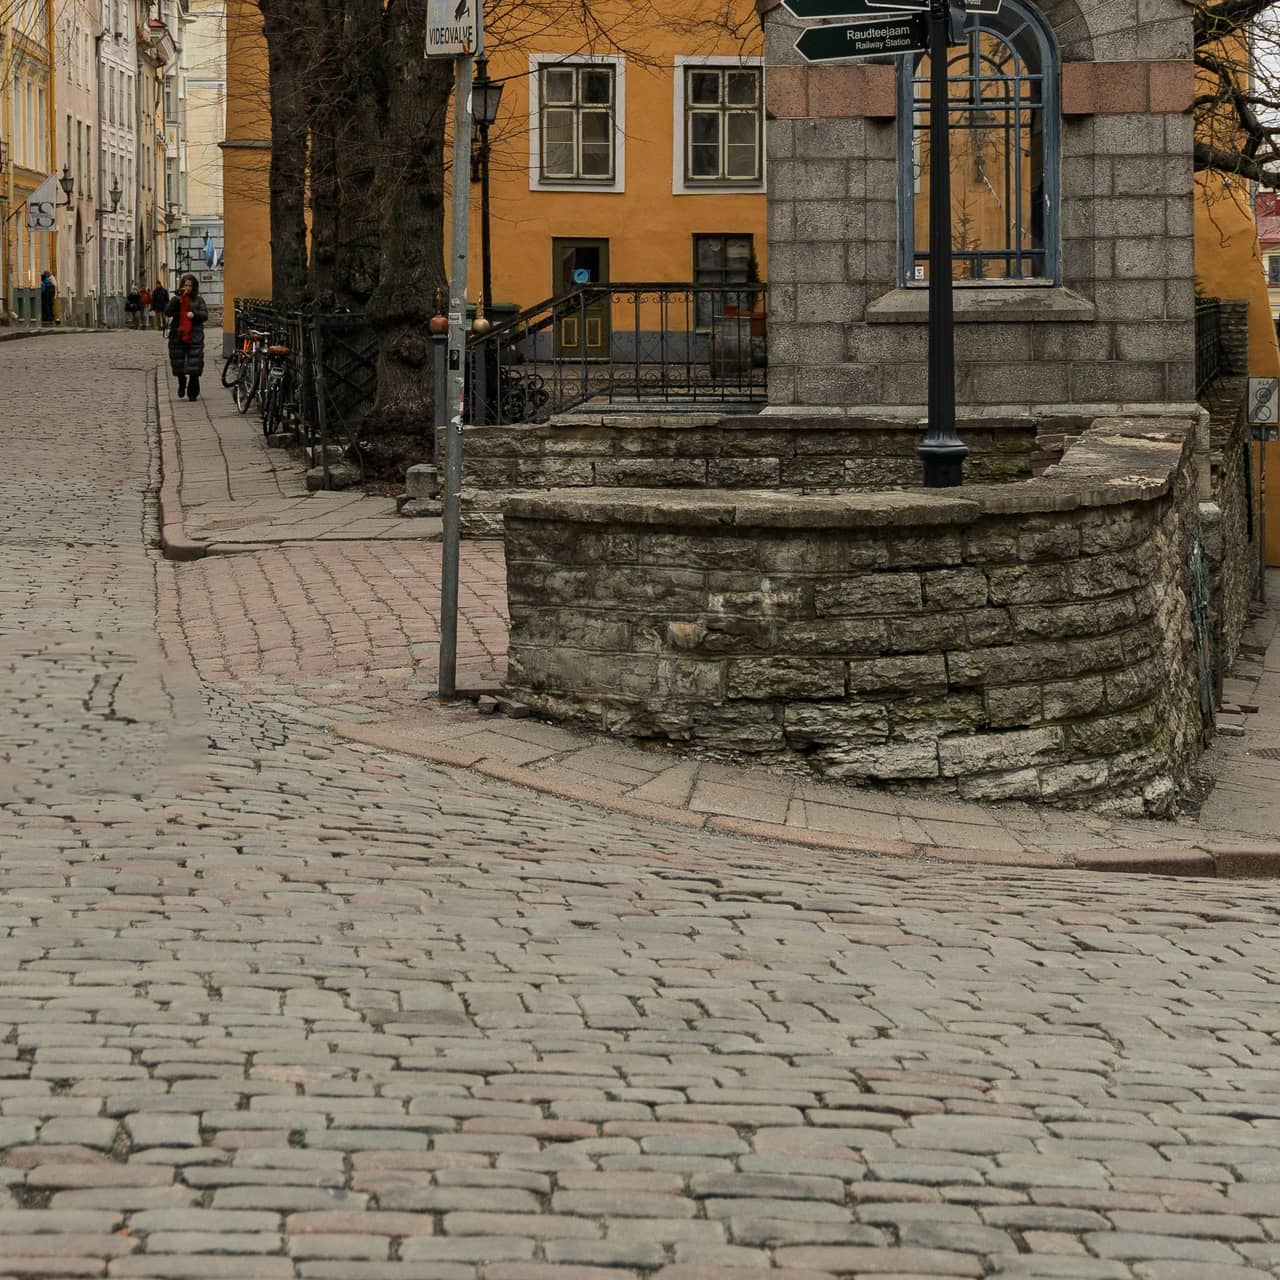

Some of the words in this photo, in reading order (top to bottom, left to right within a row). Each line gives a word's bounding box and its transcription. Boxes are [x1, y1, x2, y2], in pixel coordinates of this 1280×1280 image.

[429, 25, 473, 46] VIDEOVALVE
[847, 26, 910, 41] Raudteejaam
[856, 40, 884, 50] Railway
[885, 38, 910, 48] Station
